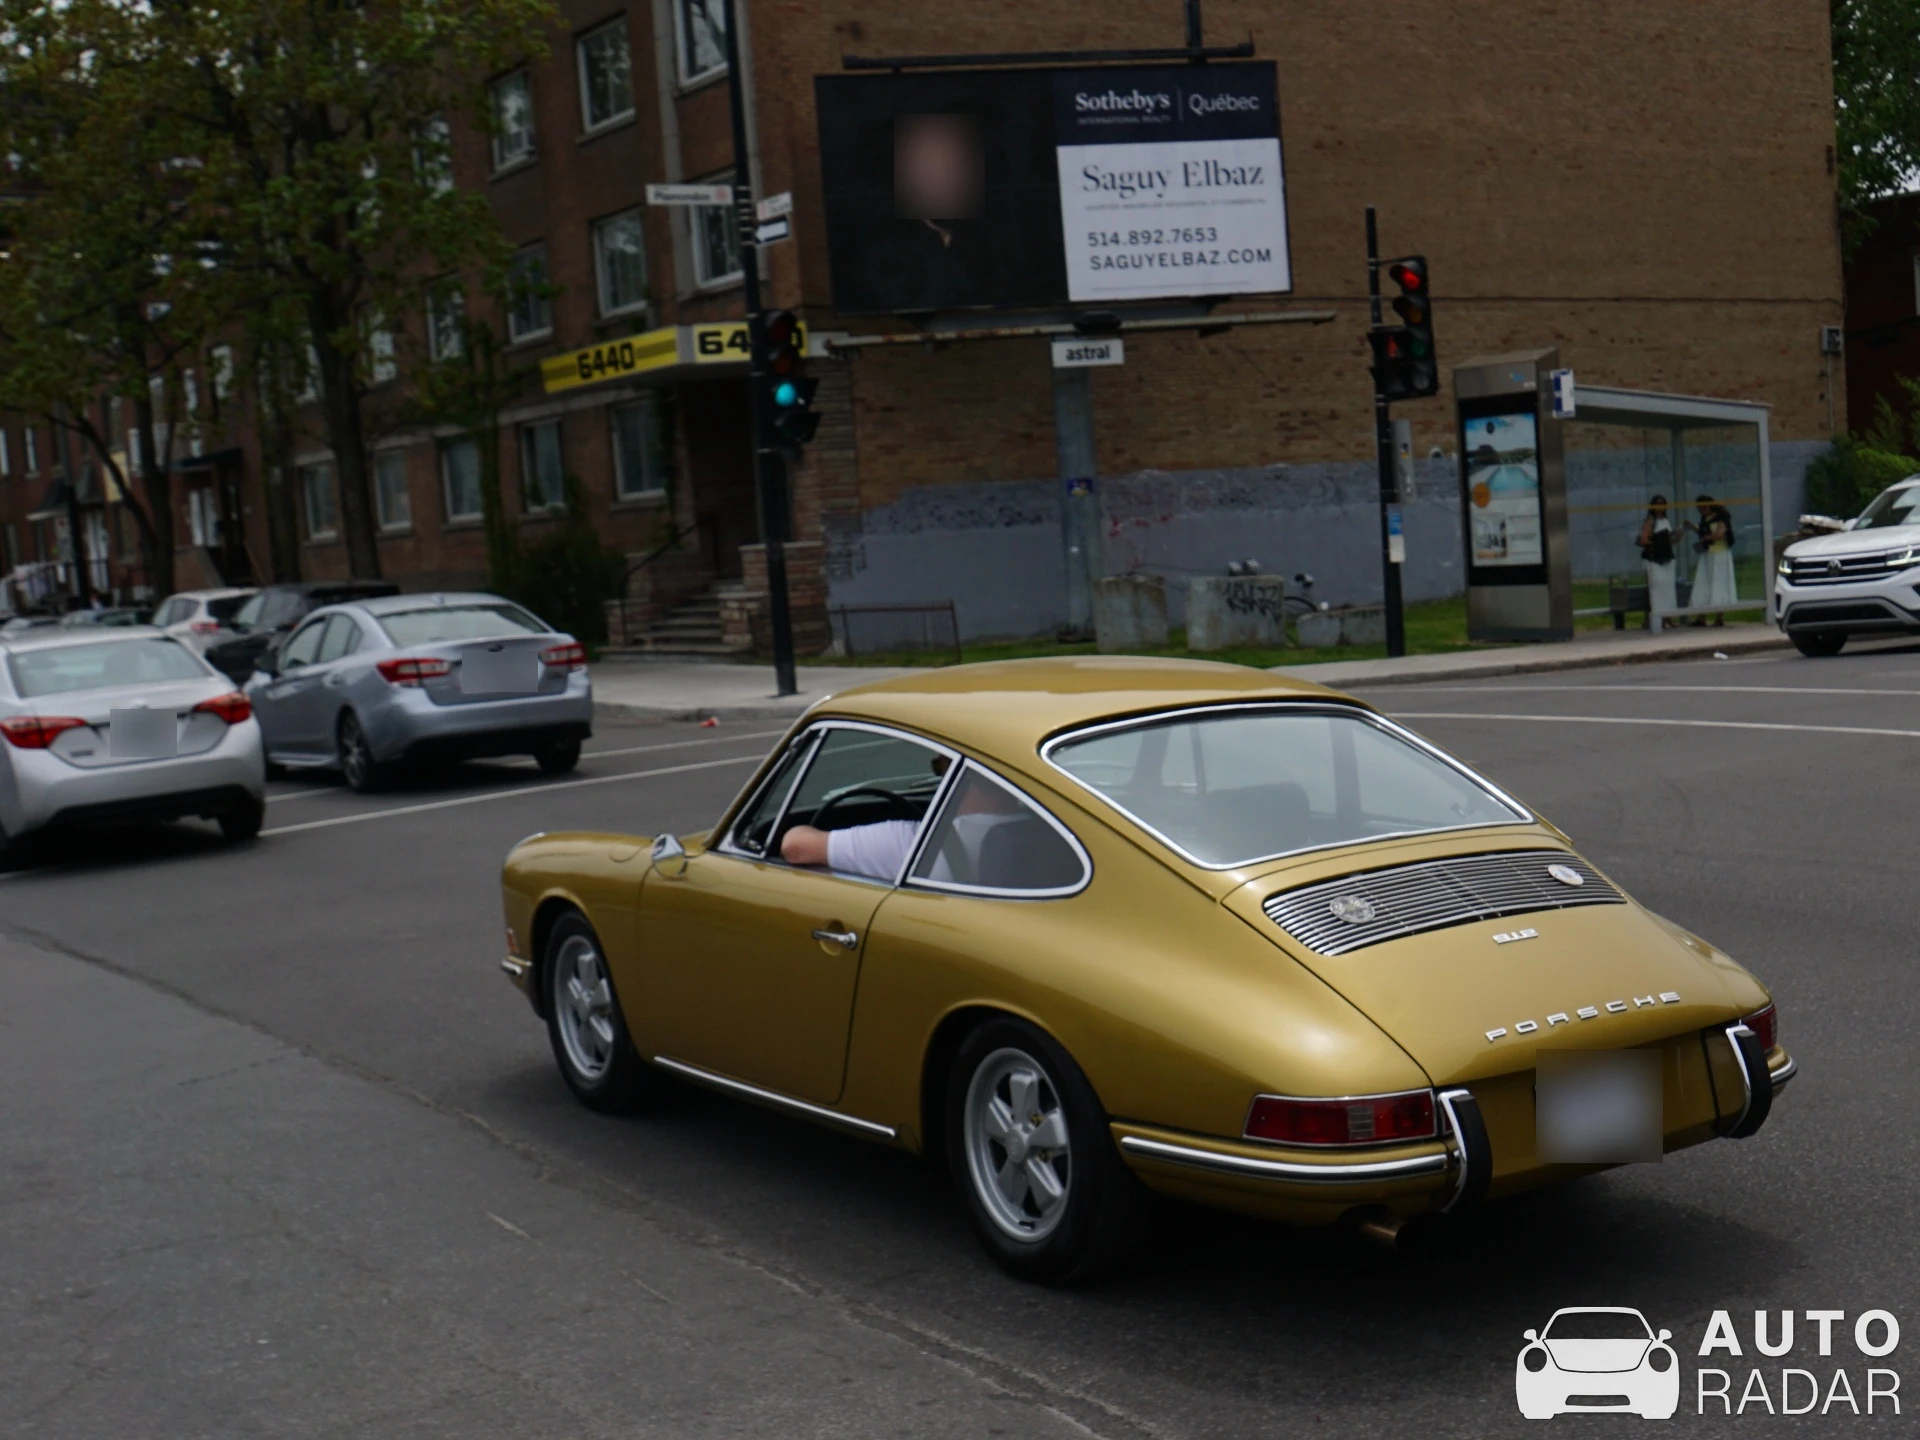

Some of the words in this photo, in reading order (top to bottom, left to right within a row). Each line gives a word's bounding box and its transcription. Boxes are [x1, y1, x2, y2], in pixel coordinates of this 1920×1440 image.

[1075, 89, 1171, 113] Sotheby's
[1189, 93, 1261, 116] Québec
[1082, 164, 1170, 200] Saguy
[1183, 158, 1265, 189] Elbaz
[1087, 227, 1219, 248] 514.892.7653
[1089, 247, 1273, 272] SAGUYELBAZ.COM
[577, 342, 635, 381] 6440
[1066, 343, 1110, 361] astral
[1485, 991, 1681, 1042] PORSCHE
